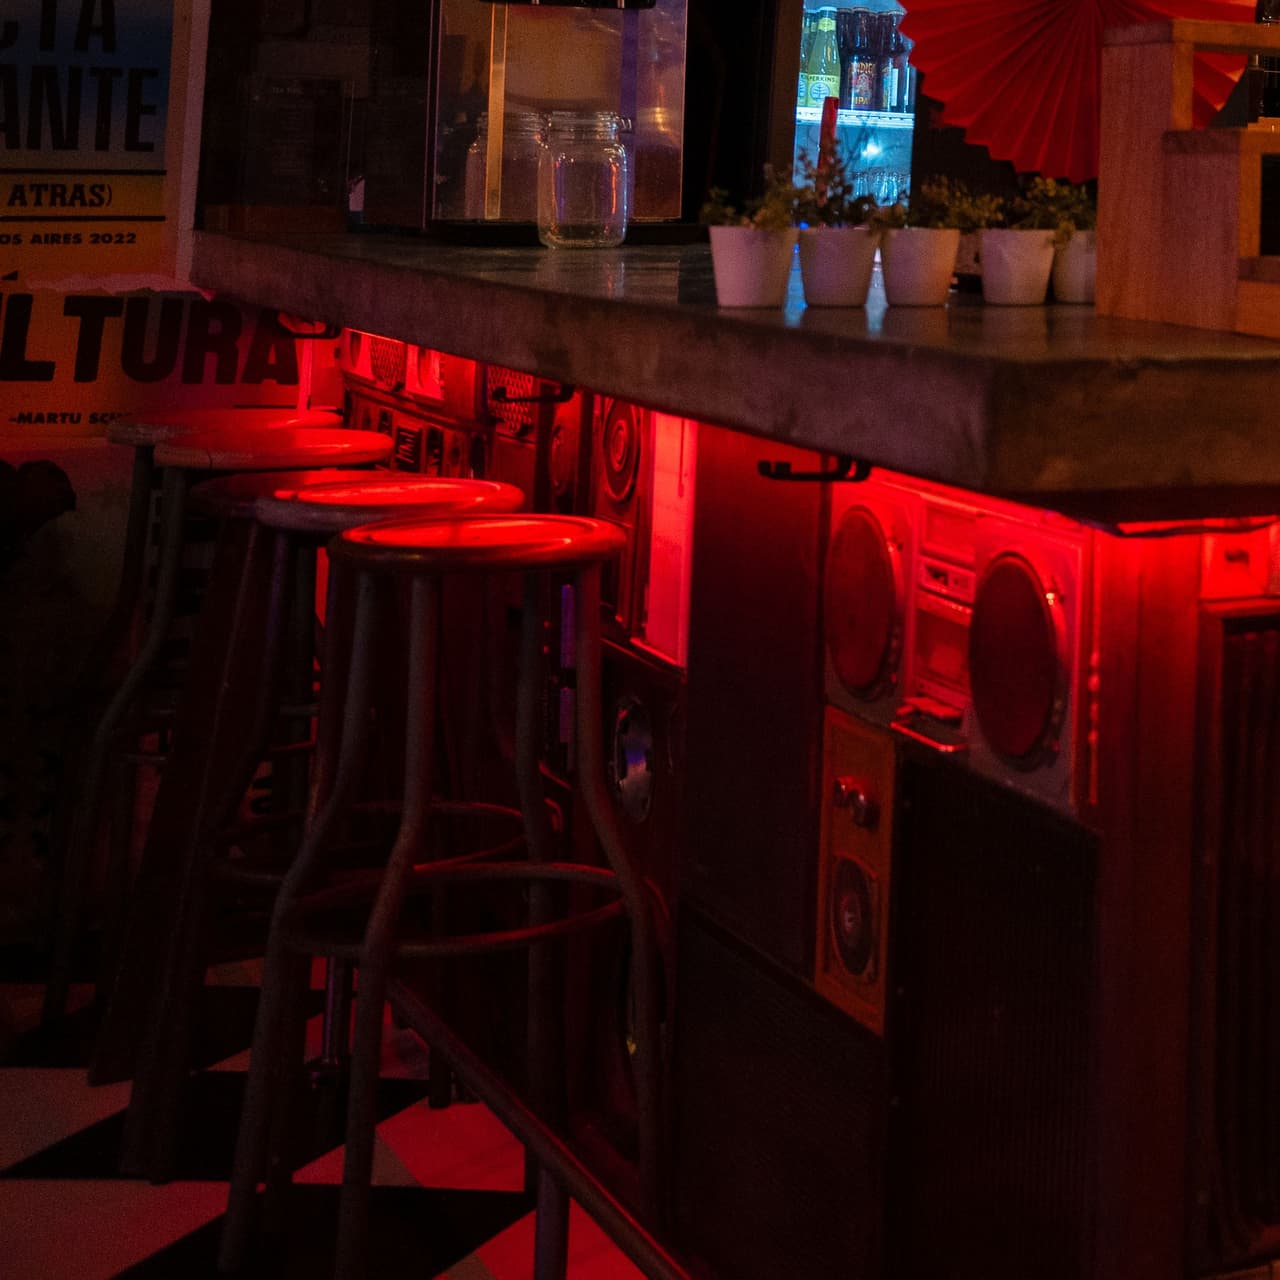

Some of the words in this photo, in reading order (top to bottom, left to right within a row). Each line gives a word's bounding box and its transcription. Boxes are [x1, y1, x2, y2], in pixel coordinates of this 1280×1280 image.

[8, 182, 113, 209] ATRAS)
[31, 233, 82, 245] AIRES
[90, 232, 137, 245] 2022
[0, 291, 299, 385] LTURA
